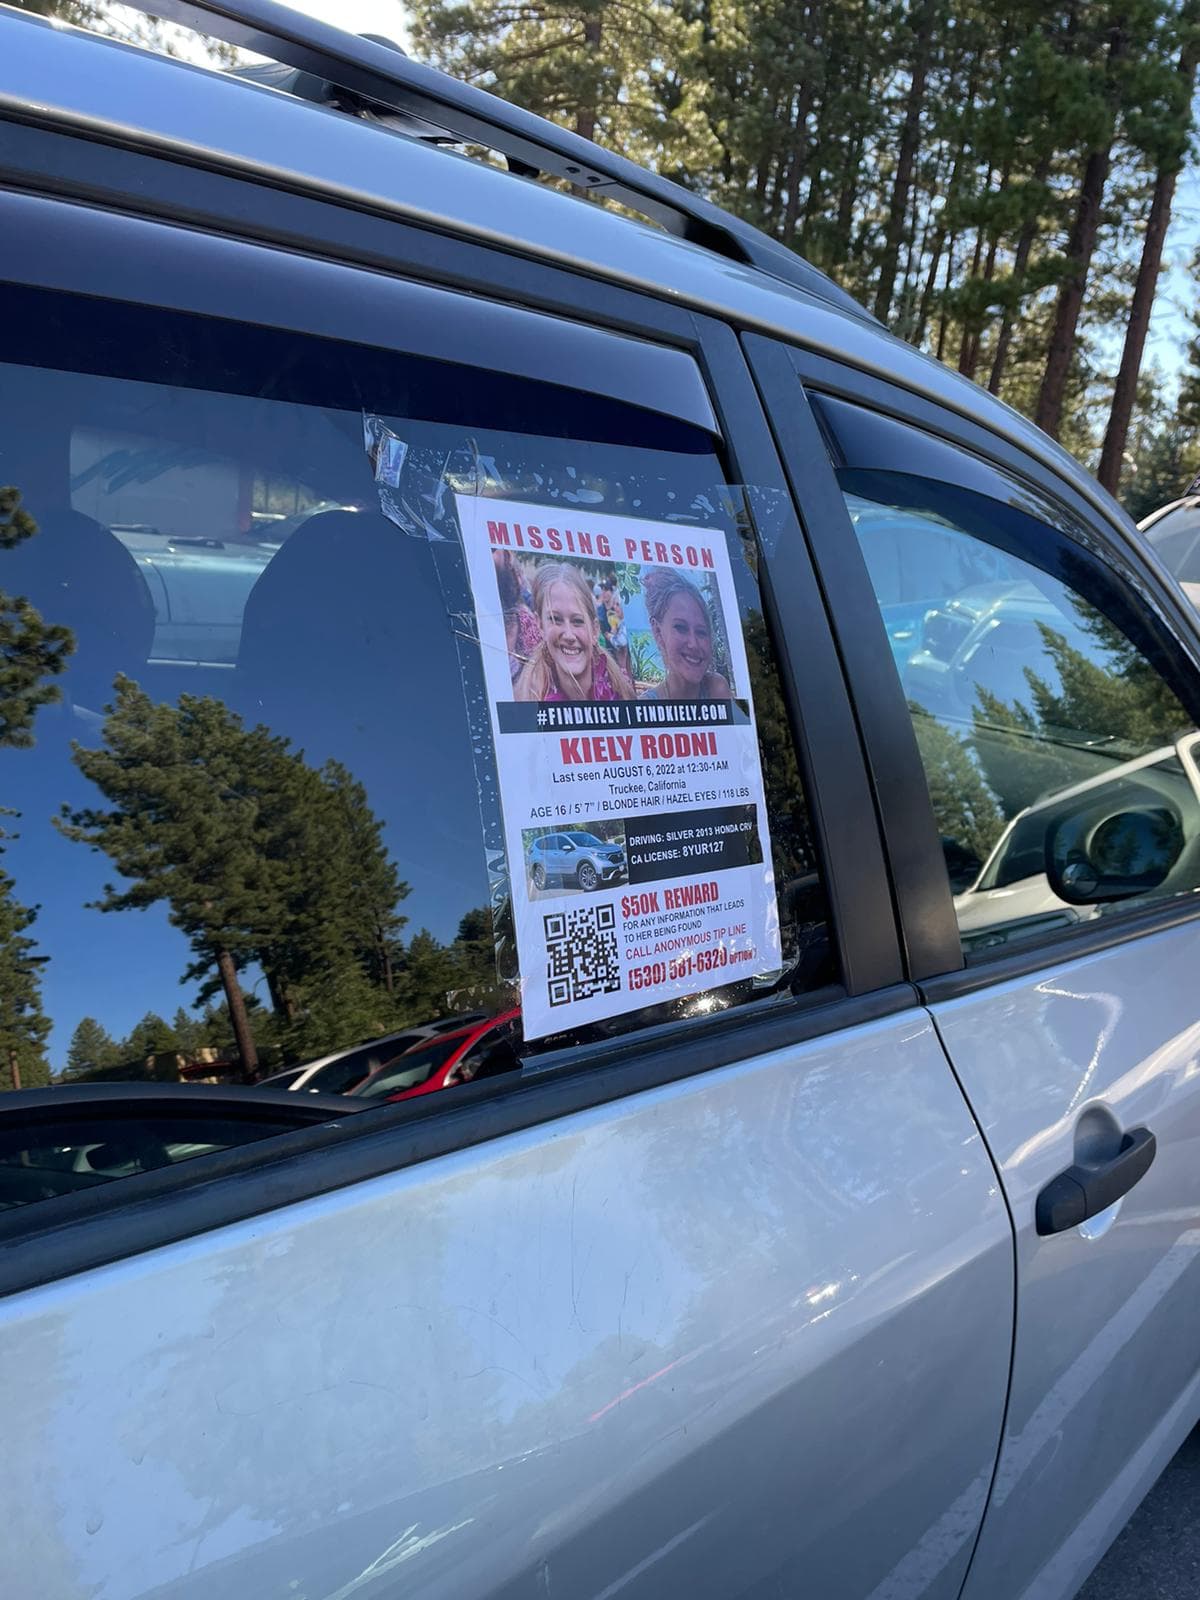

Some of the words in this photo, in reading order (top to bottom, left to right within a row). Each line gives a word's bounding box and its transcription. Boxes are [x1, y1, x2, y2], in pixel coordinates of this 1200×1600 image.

[487, 520, 611, 557] MISSING
[625, 538, 714, 569] PERSON
[537, 707, 620, 725] #FINDKIELY
[635, 704, 728, 723] FINDKIELY.COM
[560, 735, 633, 765] KIELY
[641, 731, 717, 760] RODNI
[552, 772, 575, 783] Last
[577, 771, 601, 782] seen
[603, 766, 643, 779] AUGUST
[646, 765, 654, 777] 6,
[656, 764, 676, 775] 2022
[677, 764, 685, 774] at
[687, 761, 729, 773] 12:30-1AM
[609, 783, 645, 795] Truckee,
[647, 779, 687, 792] California
[530, 806, 552, 818] AGE
[555, 805, 566, 816] 16
[602, 797, 639, 811] BLONDE
[641, 795, 661, 807] HAIR
[666, 792, 693, 804] HAZEL
[695, 790, 717, 802] EYES
[722, 788, 735, 799] 118
[736, 787, 750, 797] LBS
[629, 834, 665, 847] DRIVING:
[666, 830, 694, 842] SILVER
[696, 827, 713, 838] 2013
[714, 824, 739, 835] HONDA
[739, 821, 753, 831] CRV
[631, 854, 643, 865] CA
[644, 849, 681, 863] LICENSE:
[682, 841, 724, 857] 8YUR127
[621, 891, 660, 920] $50K
[664, 881, 719, 910] REWARD
[623, 920, 639, 931] FOR
[640, 918, 656, 928] ANY
[657, 907, 706, 924] INFORMATION
[707, 903, 723, 914] THAT
[724, 899, 745, 911] LEADS
[624, 934, 635, 944] TO
[636, 930, 652, 941] HER
[654, 925, 677, 937] BEING
[678, 920, 703, 932] FOUND
[625, 946, 652, 960] CALL
[653, 932, 711, 954] ANONYMOUS
[713, 928, 726, 940] TIP
[727, 923, 747, 937] LINE
[628, 962, 666, 991] (530)
[669, 946, 728, 981] 581-6320
